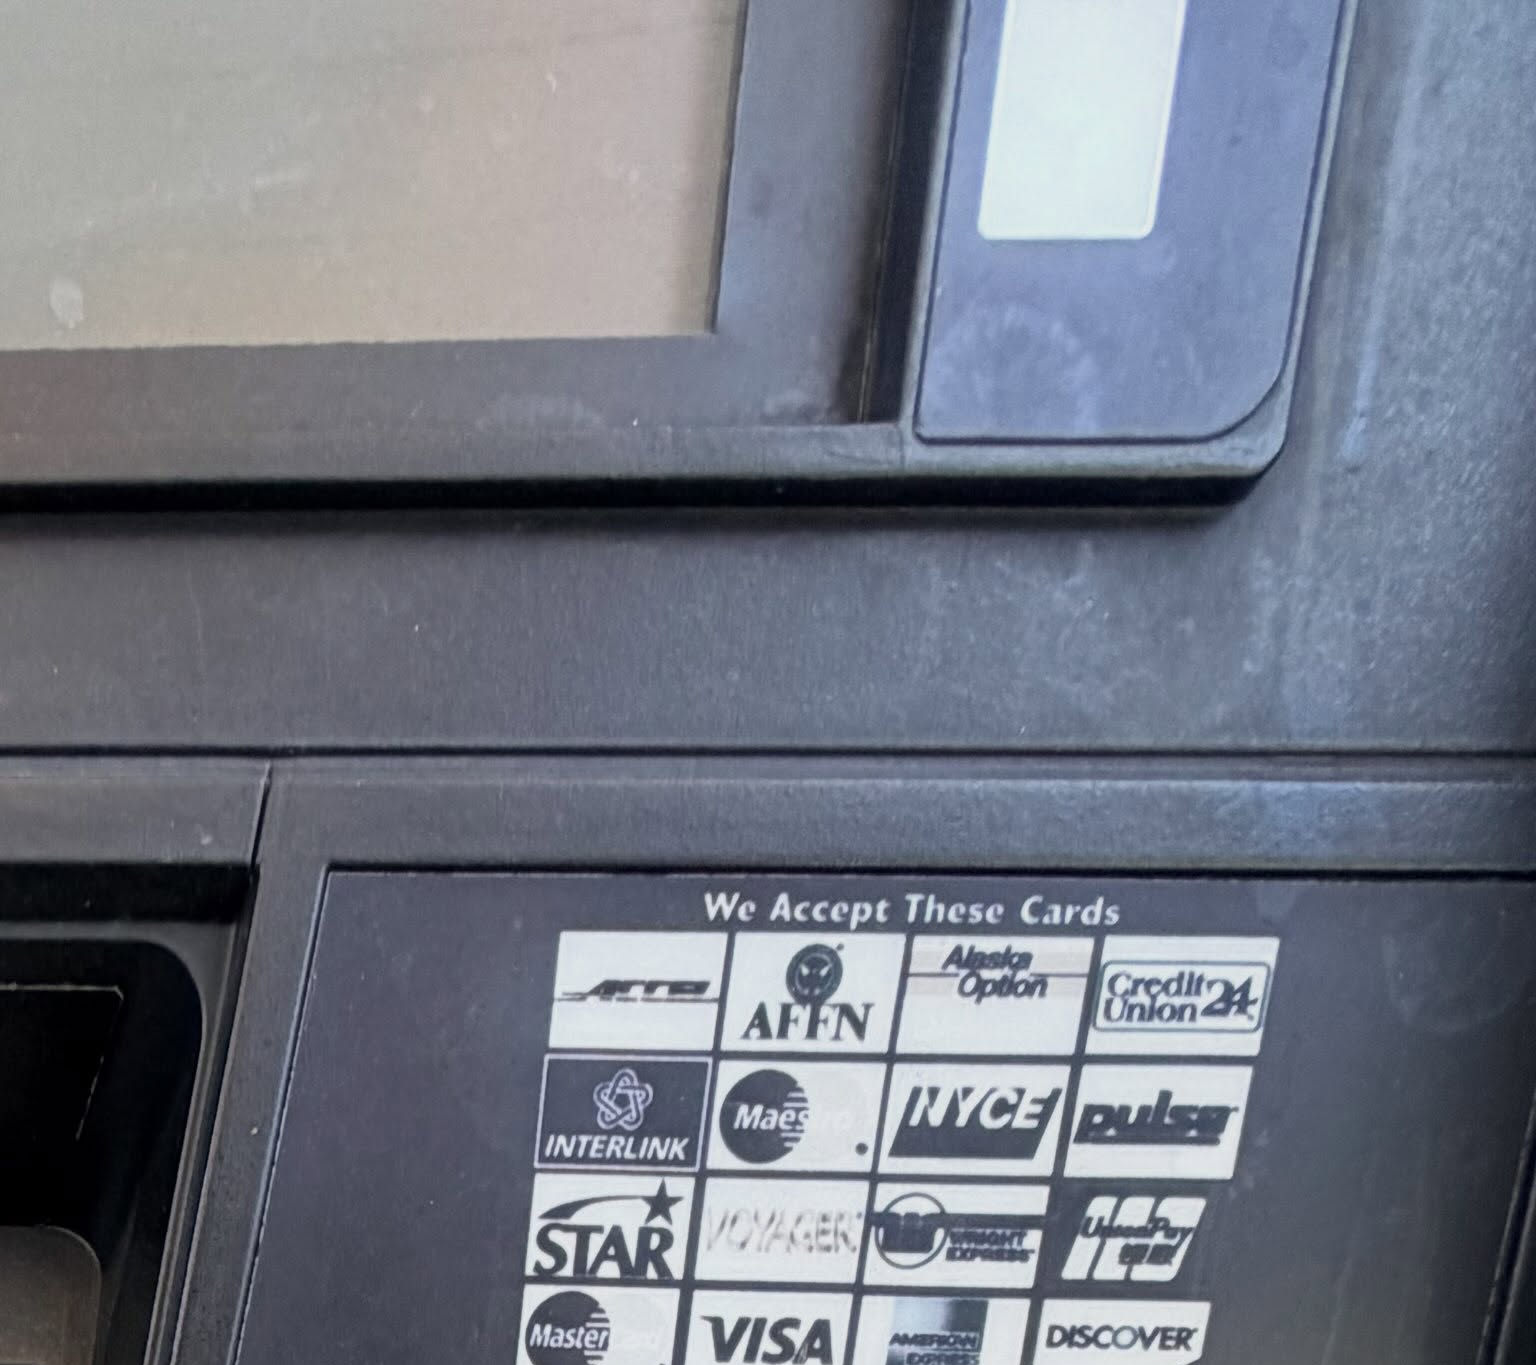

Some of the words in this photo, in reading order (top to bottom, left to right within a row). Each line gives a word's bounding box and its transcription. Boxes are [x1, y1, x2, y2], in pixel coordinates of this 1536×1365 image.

[704, 892, 756, 922] We
[769, 892, 890, 931] Accept
[904, 892, 1005, 925] These
[1020, 895, 1121, 926] Cards
[941, 943, 1033, 972] Alaska
[958, 971, 1049, 1005] Option
[1107, 969, 1205, 998] Credit
[1200, 976, 1259, 1020] 24
[739, 1000, 875, 1042] AFFN
[1103, 997, 1197, 1024] Union
[908, 1085, 1062, 1131] NYCE
[544, 1133, 690, 1161] INTERLINK
[532, 1222, 675, 1280] STAR
[700, 1315, 834, 1365] VISA
[1044, 1324, 1197, 1352] DISCOVER
